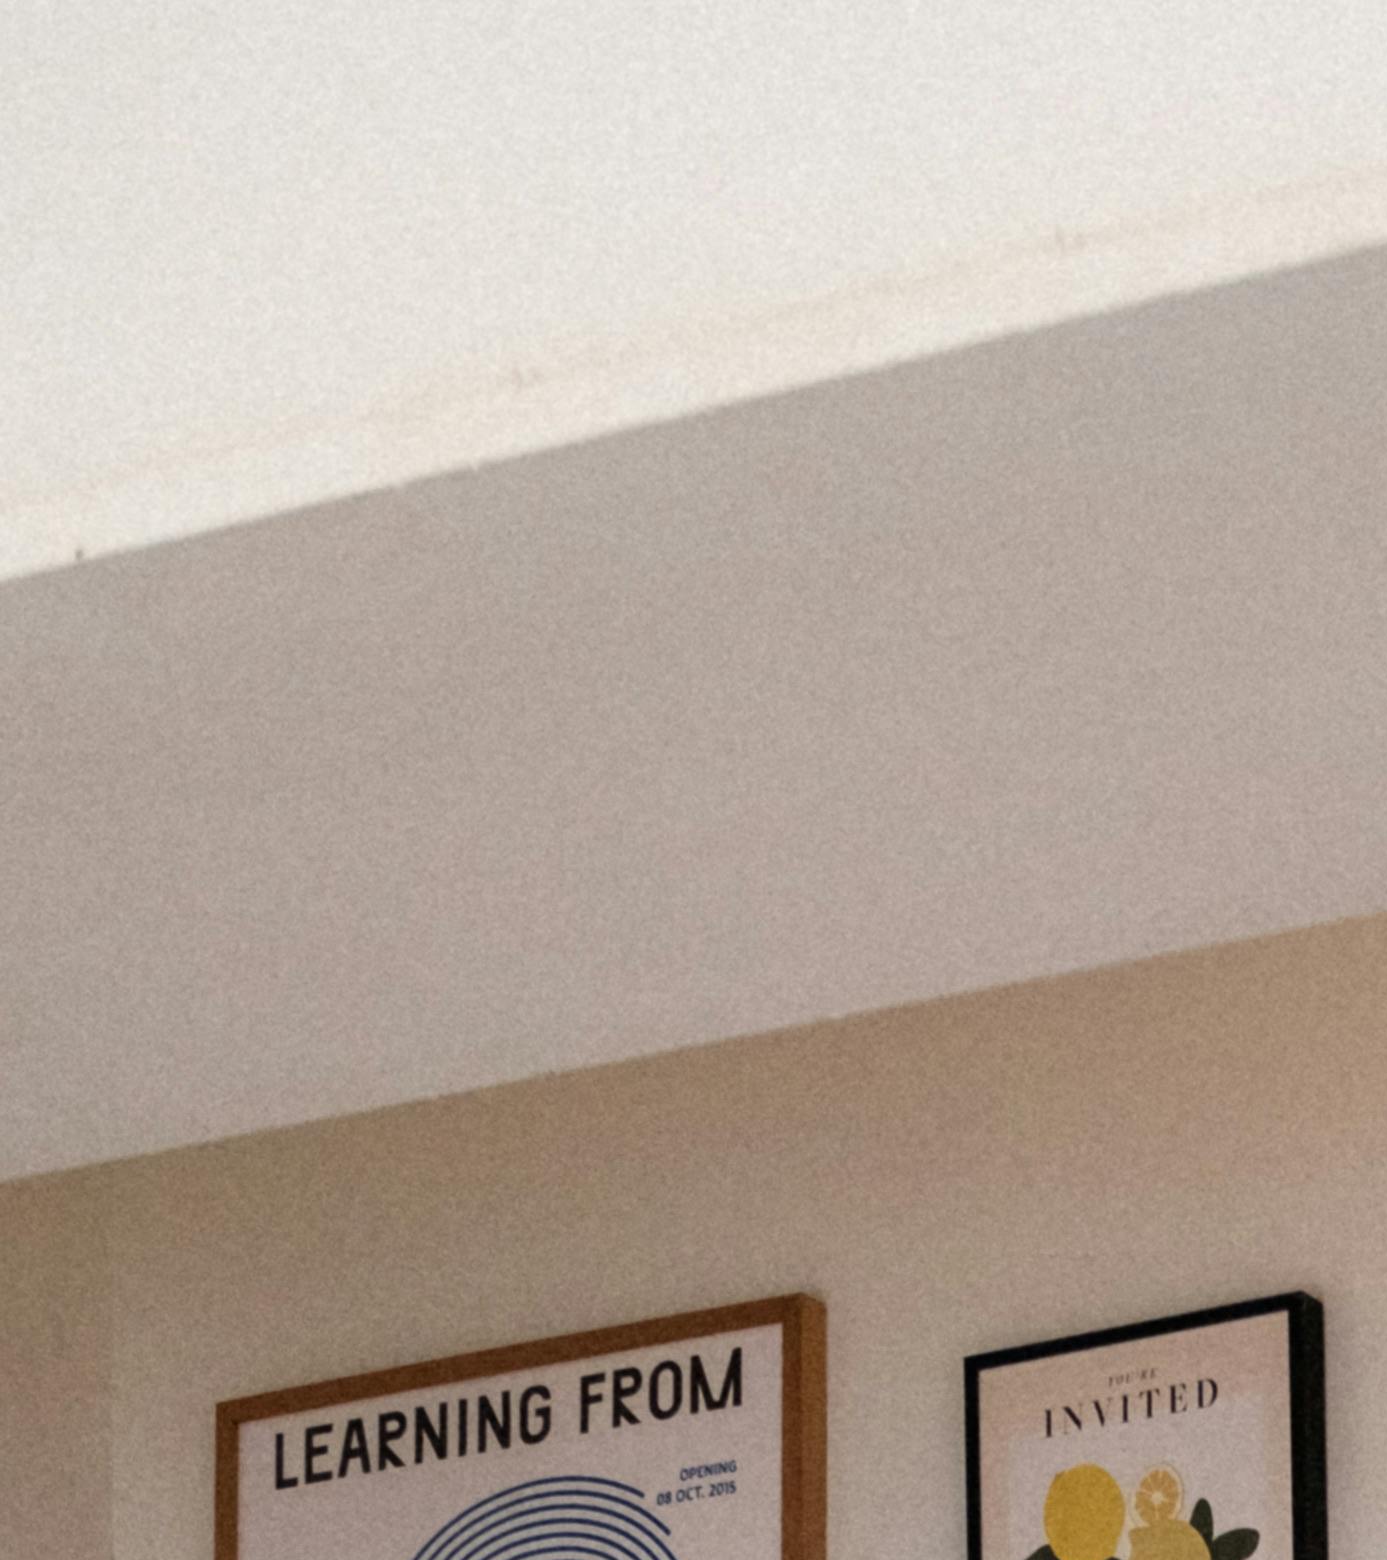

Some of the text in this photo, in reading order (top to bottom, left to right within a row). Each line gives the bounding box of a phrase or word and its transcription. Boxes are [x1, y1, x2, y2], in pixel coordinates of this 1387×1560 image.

[274, 1345, 745, 1491] LEARNING FROM
[1044, 1378, 1220, 1439] INVITED
[679, 1459, 737, 1481] OPENING
[656, 1480, 737, 1508] 08 OCT. 2015
